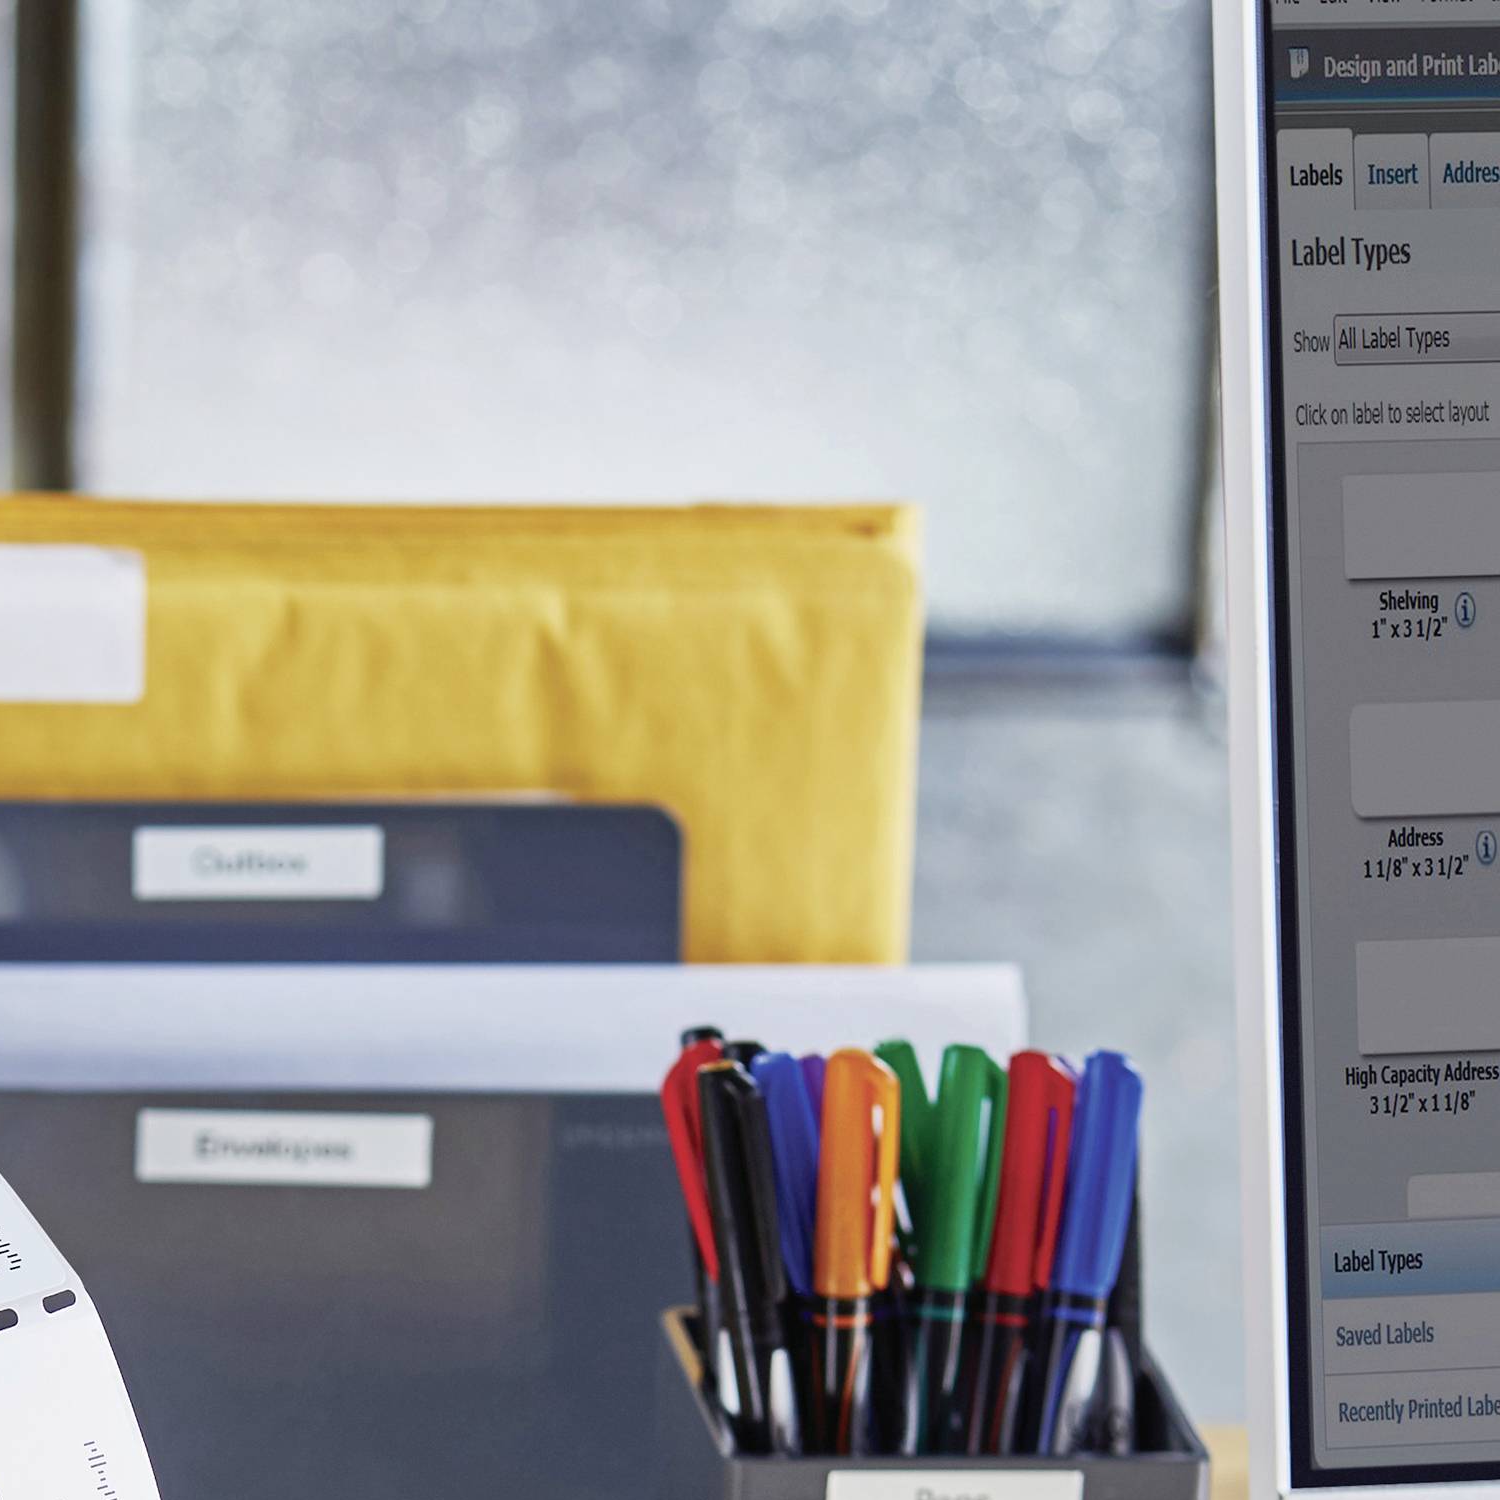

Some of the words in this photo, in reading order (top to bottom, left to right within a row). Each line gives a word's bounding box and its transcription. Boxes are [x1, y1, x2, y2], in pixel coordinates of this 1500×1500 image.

[1324, 54, 1381, 84] Design
[1386, 53, 1417, 77] and
[1423, 53, 1464, 76] Print
[1469, 52, 1500, 76] Lab
[1290, 163, 1343, 187] Labels
[1367, 163, 1418, 186] Insert
[1291, 236, 1345, 267] Label
[1351, 238, 1411, 271] Types
[1293, 329, 1330, 352] Show
[1338, 326, 1356, 350] All
[1362, 325, 1401, 349] Label
[1405, 326, 1450, 354] Types
[1296, 402, 1327, 426] Click
[1331, 408, 1348, 425] on
[1352, 401, 1383, 424] label
[1388, 404, 1402, 424] to
[1405, 401, 1444, 424] select
[1449, 400, 1490, 426] layout
[1379, 590, 1439, 613] Shelving
[1371, 617, 1387, 639] 1"
[1390, 623, 1400, 638] x
[1402, 618, 1413, 638] 3
[1416, 616, 1448, 641] 1/2"
[1388, 826, 1444, 848] Address
[1363, 860, 1373, 879] 1
[1376, 856, 1408, 882] 1/8"
[1412, 862, 1421, 877] x
[1424, 857, 1434, 876] 3
[1438, 855, 1469, 880] 1/2"
[1345, 1064, 1377, 1089] High
[1381, 1064, 1440, 1087] Capacity
[1444, 1060, 1500, 1081] Address
[1370, 1096, 1379, 1114] 3
[1383, 1093, 1415, 1117] 1/2"
[1418, 1098, 1428, 1112] x
[1432, 1094, 1440, 1112] 1
[1445, 1090, 1476, 1115] 1/8"
[1334, 1249, 1374, 1273] Label
[1378, 1250, 1423, 1275] Types
[1336, 1322, 1381, 1347] Saved
[1386, 1321, 1434, 1345] Labels
[1339, 1398, 1404, 1424] Recently
[1409, 1394, 1462, 1419] Printed
